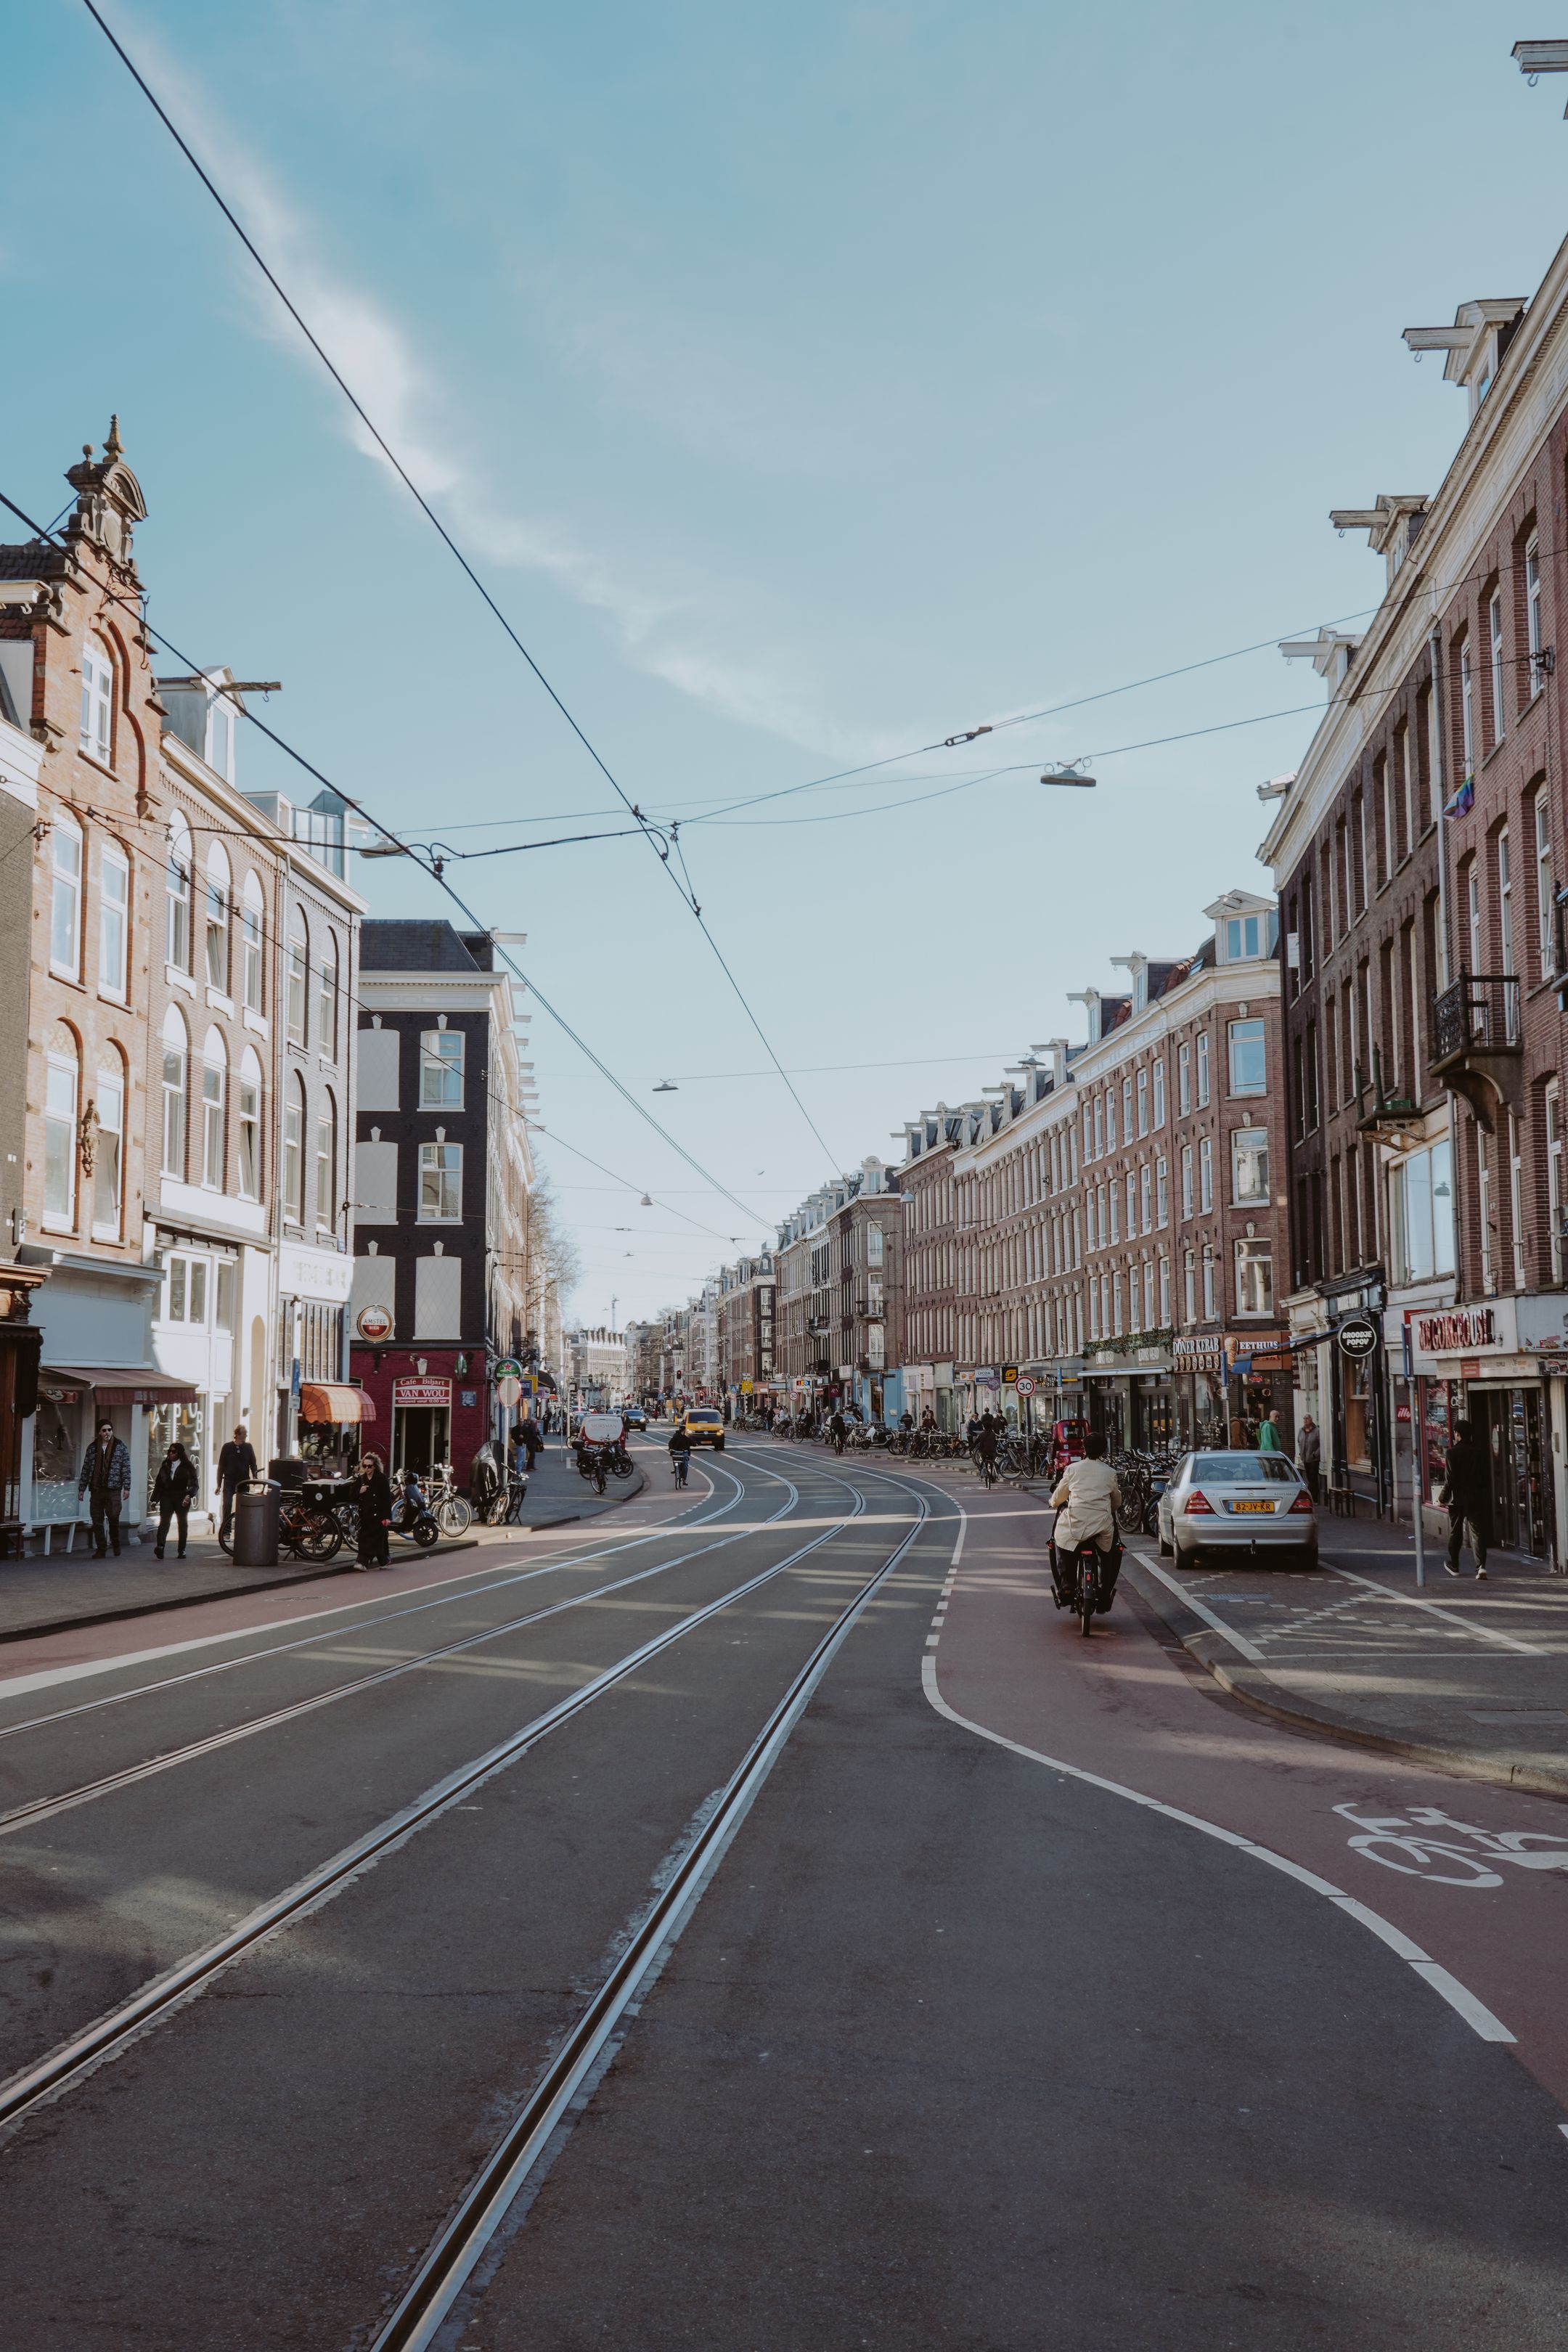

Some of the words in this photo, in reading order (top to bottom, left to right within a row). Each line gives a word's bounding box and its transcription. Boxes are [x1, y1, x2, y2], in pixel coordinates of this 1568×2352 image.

[1172, 1339, 1195, 1355] DÖNER
[1196, 1337, 1220, 1353] KEBAB
[1239, 1341, 1278, 1349] EETHUIS
[422, 1378, 445, 1387] Biljart
[1397, 1407, 1411, 1419] illy
